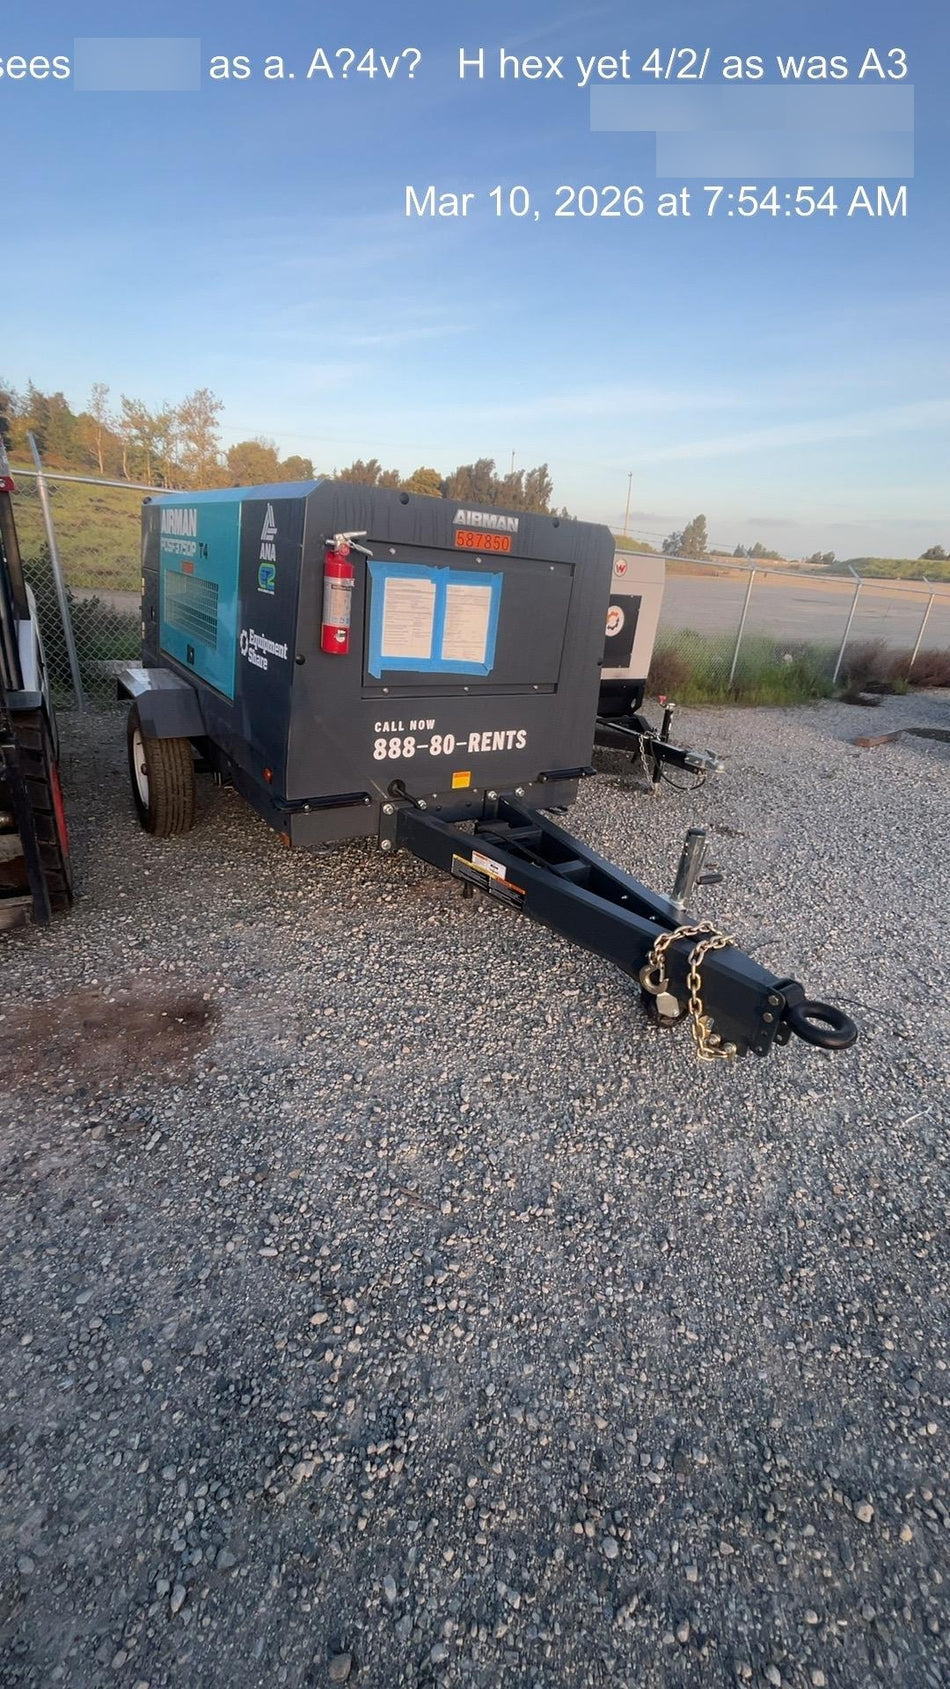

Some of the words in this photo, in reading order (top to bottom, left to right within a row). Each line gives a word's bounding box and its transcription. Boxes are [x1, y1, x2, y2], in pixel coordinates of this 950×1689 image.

[161, 508, 197, 536] AIRMAN
[452, 508, 519, 533] AIRMAN
[199, 541, 209, 560] T4
[259, 542, 276, 562] ANA
[456, 530, 511, 551] 587850
[249, 628, 288, 660] Equipment
[248, 647, 268, 671] Share
[374, 720, 405, 733] CALL
[409, 719, 436, 731] NOW
[372, 729, 528, 761] 888-80-RENTS
